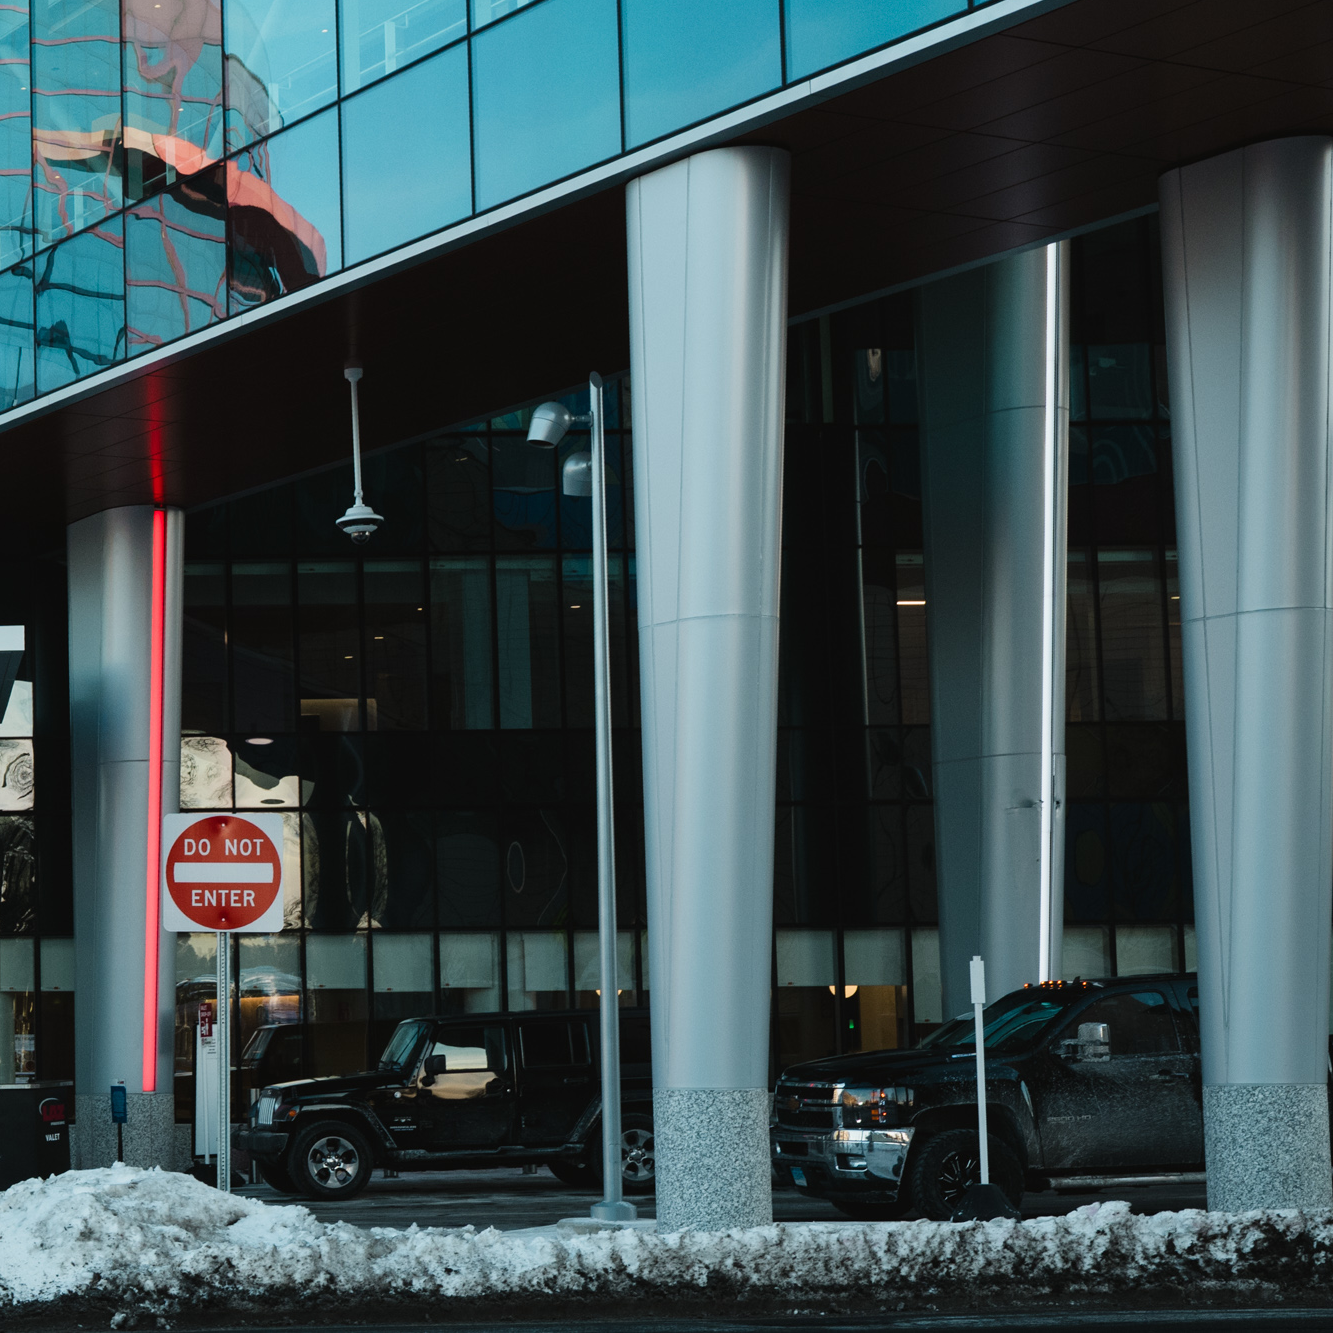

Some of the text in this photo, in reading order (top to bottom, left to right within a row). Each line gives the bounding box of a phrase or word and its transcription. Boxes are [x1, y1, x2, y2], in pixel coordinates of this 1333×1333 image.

[183, 838, 264, 856] DO NOT
[191, 889, 256, 907] ENTER
[42, 1104, 65, 1122] LAZ
[45, 1132, 61, 1142] VALET
